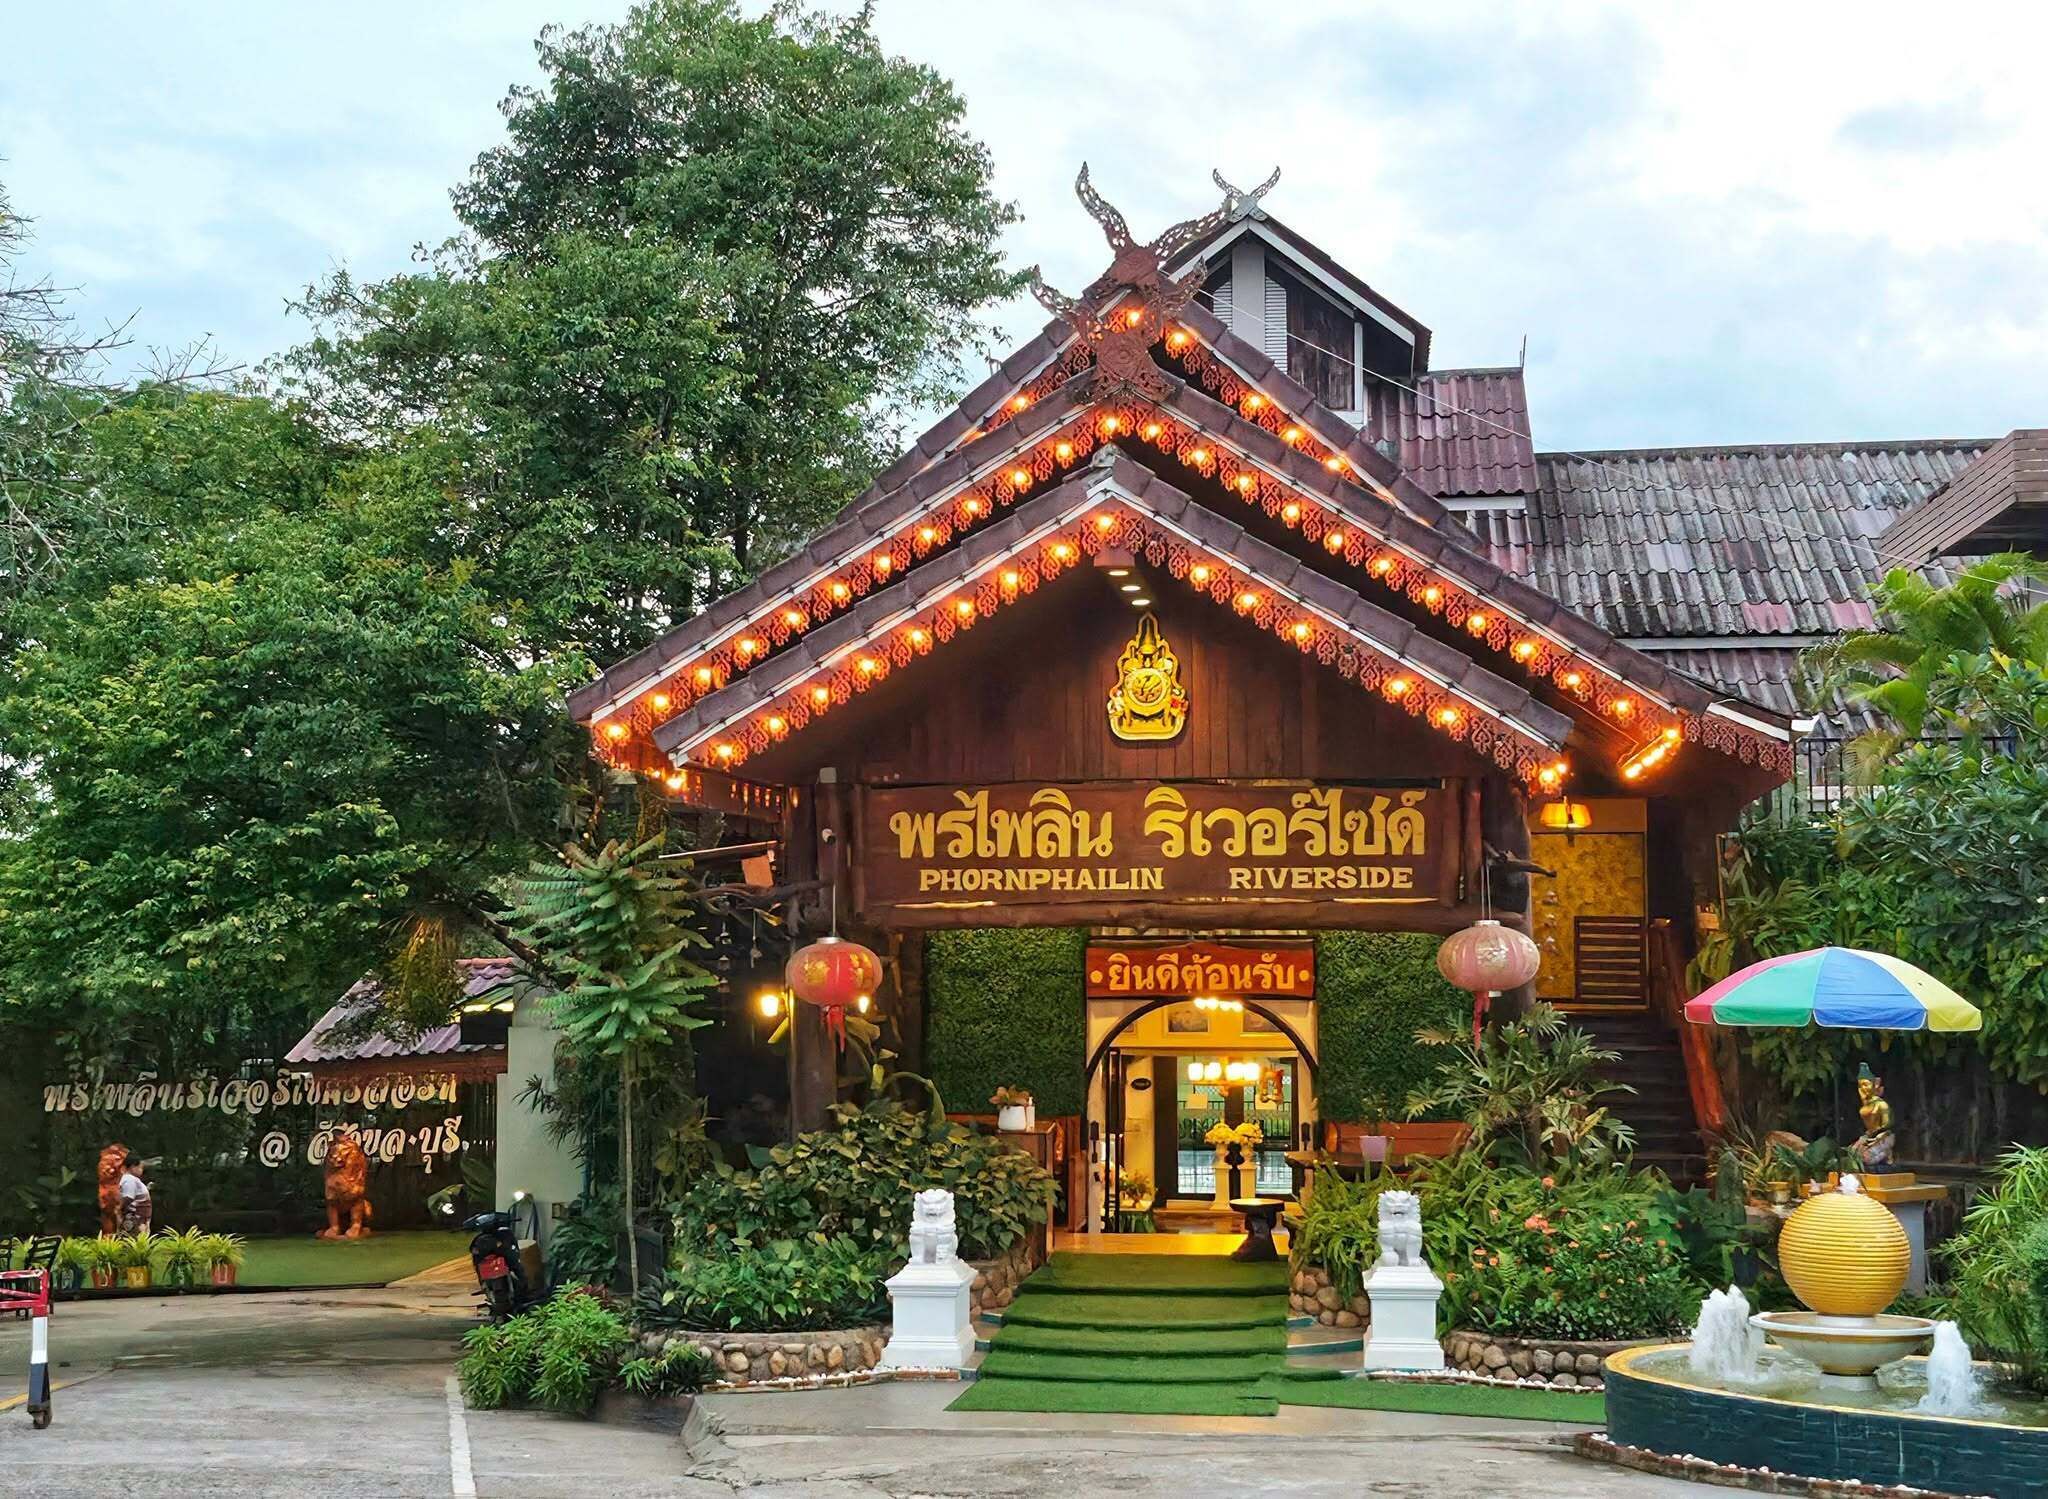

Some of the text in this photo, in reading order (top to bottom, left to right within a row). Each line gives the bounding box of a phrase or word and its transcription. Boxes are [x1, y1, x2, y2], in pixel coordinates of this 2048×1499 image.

[889, 786, 1428, 859] พรไพลิน ริเวอร์ไซด์
[919, 866, 1414, 892] PHORNPHAILIN RIVERSIDE
[1107, 952, 1295, 992] ยินดีต้อนรับ
